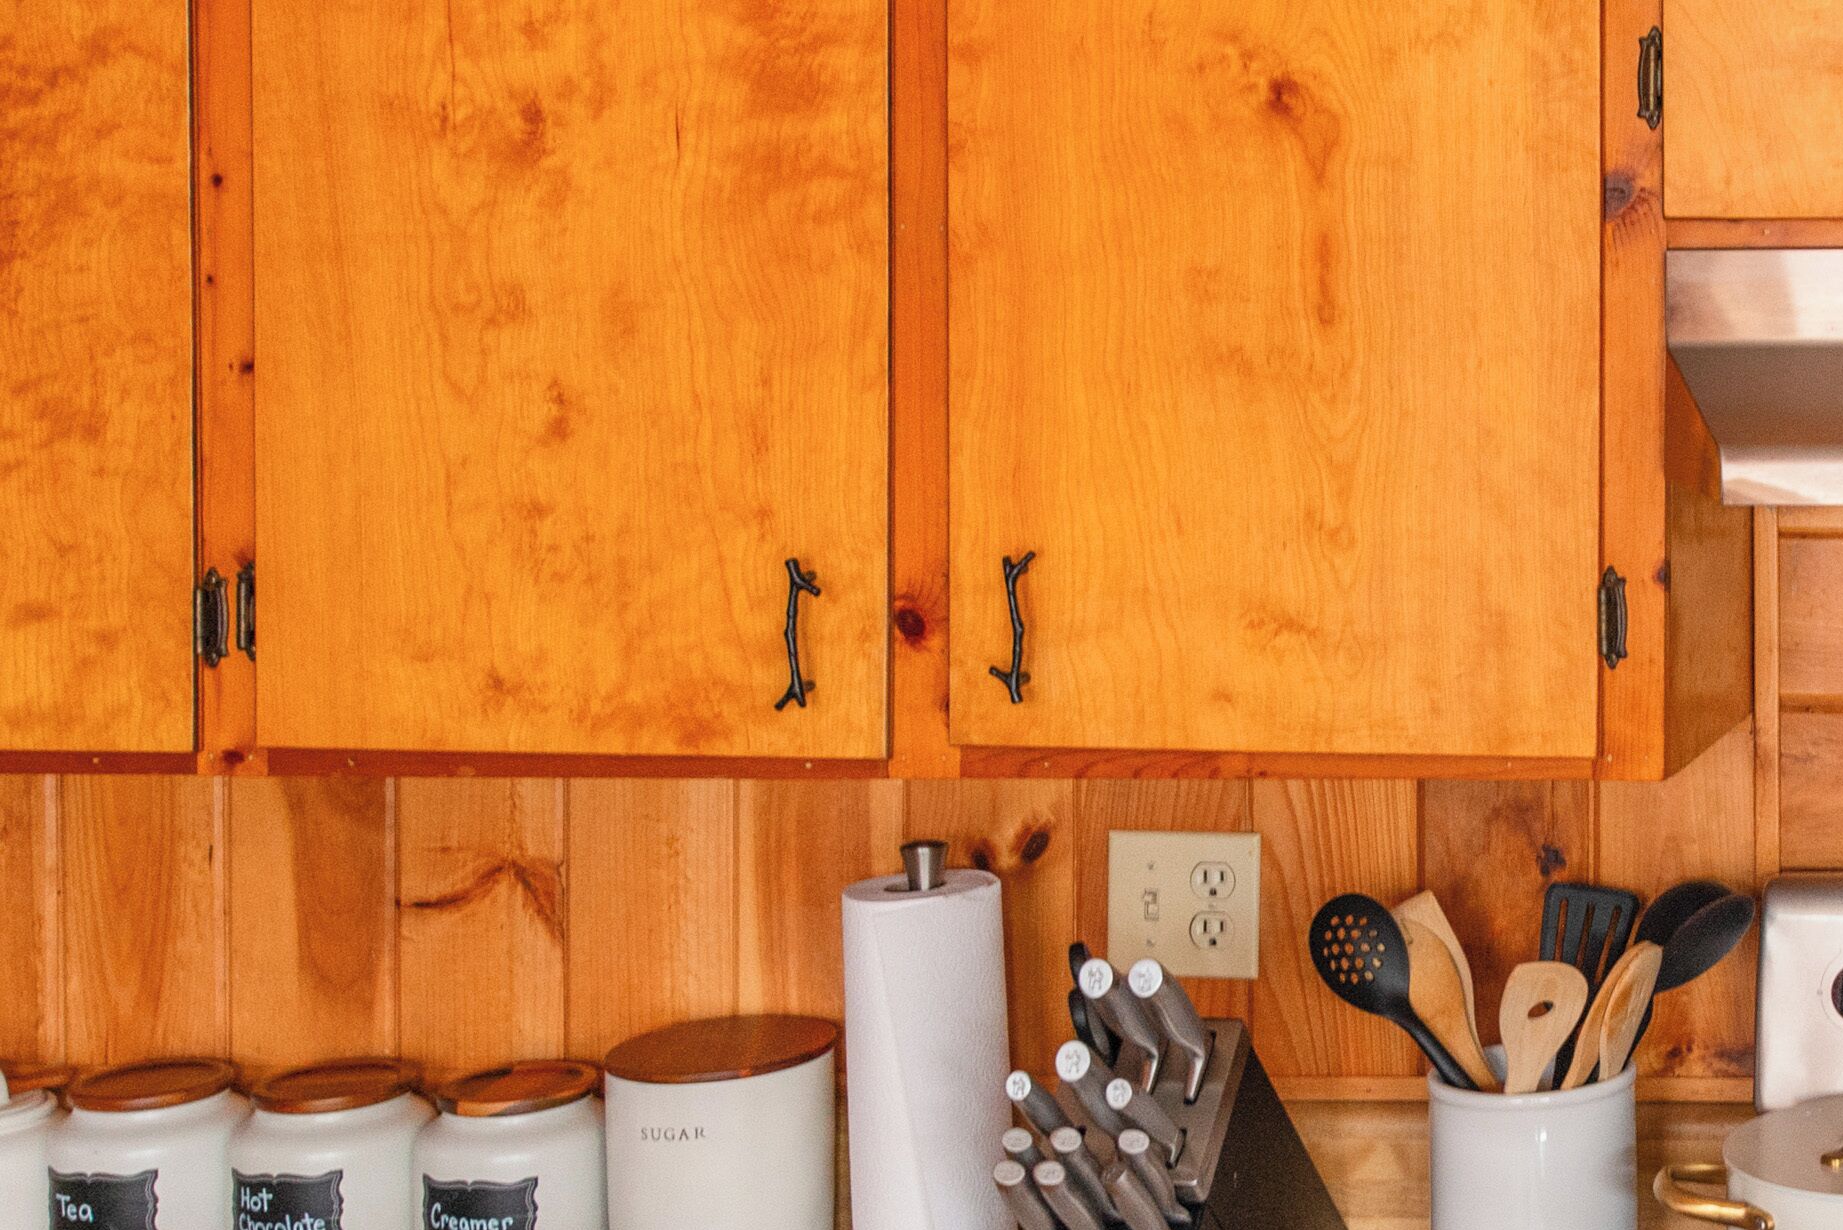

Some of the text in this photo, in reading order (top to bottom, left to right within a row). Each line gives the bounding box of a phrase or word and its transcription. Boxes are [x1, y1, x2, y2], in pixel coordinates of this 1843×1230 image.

[640, 1127, 706, 1141] SUGAR
[56, 1194, 94, 1223] Tea
[240, 1187, 273, 1213] Hot
